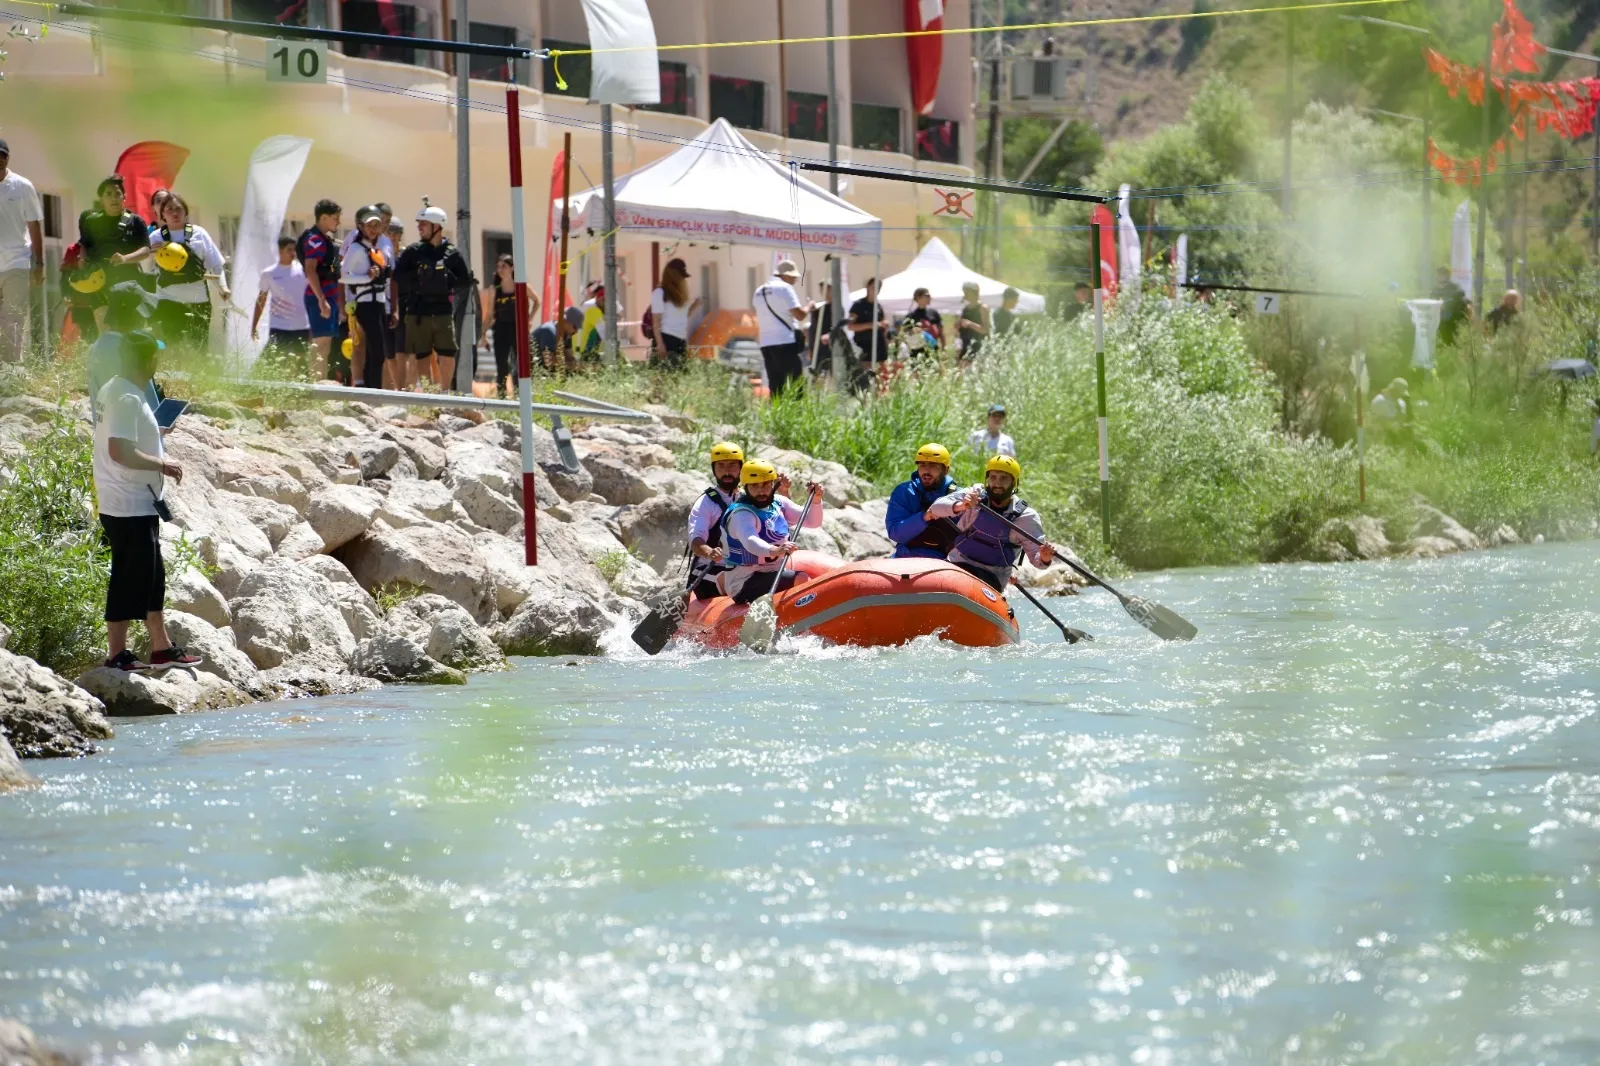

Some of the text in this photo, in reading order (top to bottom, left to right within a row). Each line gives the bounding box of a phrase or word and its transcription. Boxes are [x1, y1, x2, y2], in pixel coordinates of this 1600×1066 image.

[273, 46, 319, 77] 10
[632, 215, 655, 227] VAN
[706, 222, 720, 233] VE
[723, 223, 751, 236] SPOR
[1264, 296, 1272, 311] 7
